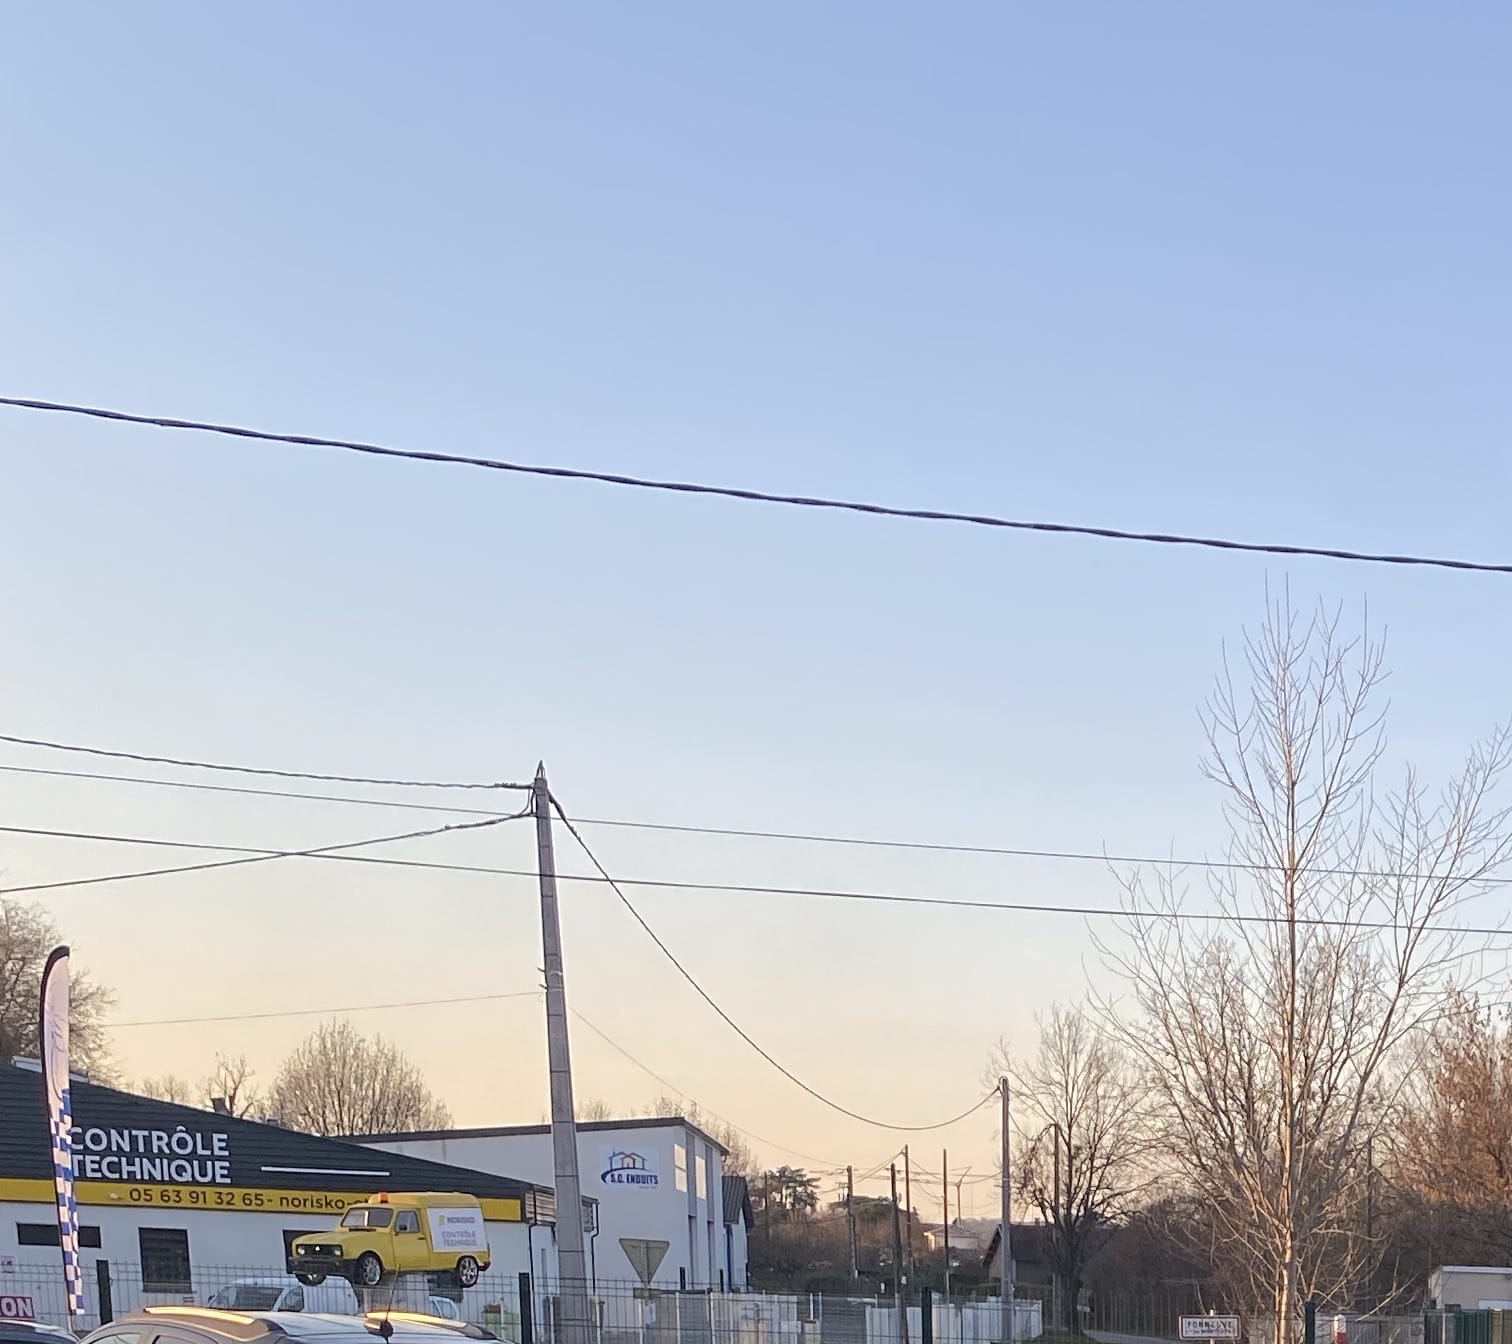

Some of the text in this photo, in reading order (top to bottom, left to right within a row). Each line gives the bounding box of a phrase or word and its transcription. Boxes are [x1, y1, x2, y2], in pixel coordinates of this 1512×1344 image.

[70, 1125, 230, 1156] CONTRÔLE
[71, 1154, 232, 1184] TECHNIQUE
[129, 1188, 153, 1202] 05
[160, 1189, 182, 1204] 63
[188, 1190, 208, 1205] 91
[214, 1191, 236, 1206] 32
